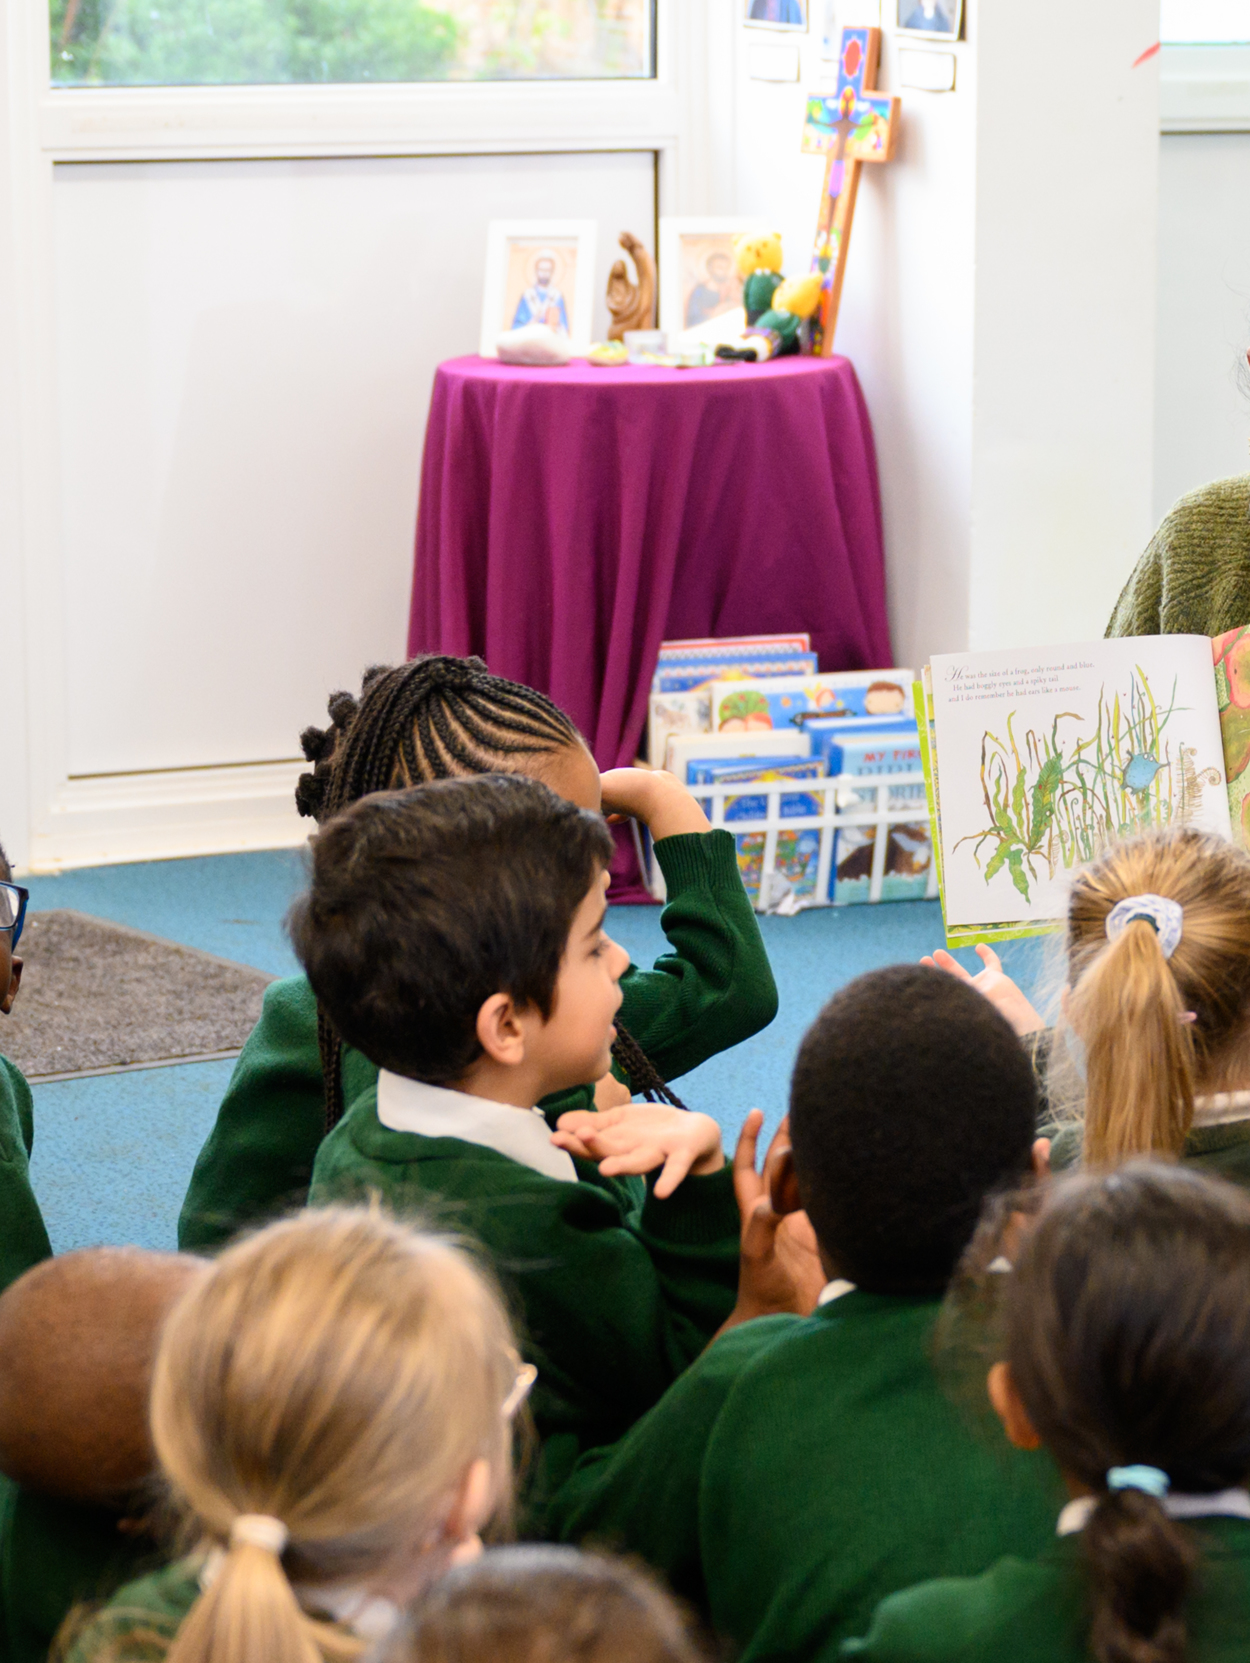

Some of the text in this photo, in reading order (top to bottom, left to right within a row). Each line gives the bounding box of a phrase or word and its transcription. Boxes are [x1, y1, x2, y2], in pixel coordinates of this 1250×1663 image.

[1015, 667, 1030, 676] frog,
[1046, 663, 1065, 671] round
[964, 682, 976, 690] had
[1013, 678, 1024, 686] and
[1030, 676, 1046, 686] spiky
[975, 690, 1006, 700] remember
[1006, 690, 1014, 698] he
[1016, 688, 1027, 698] had
[1042, 686, 1053, 694] like
